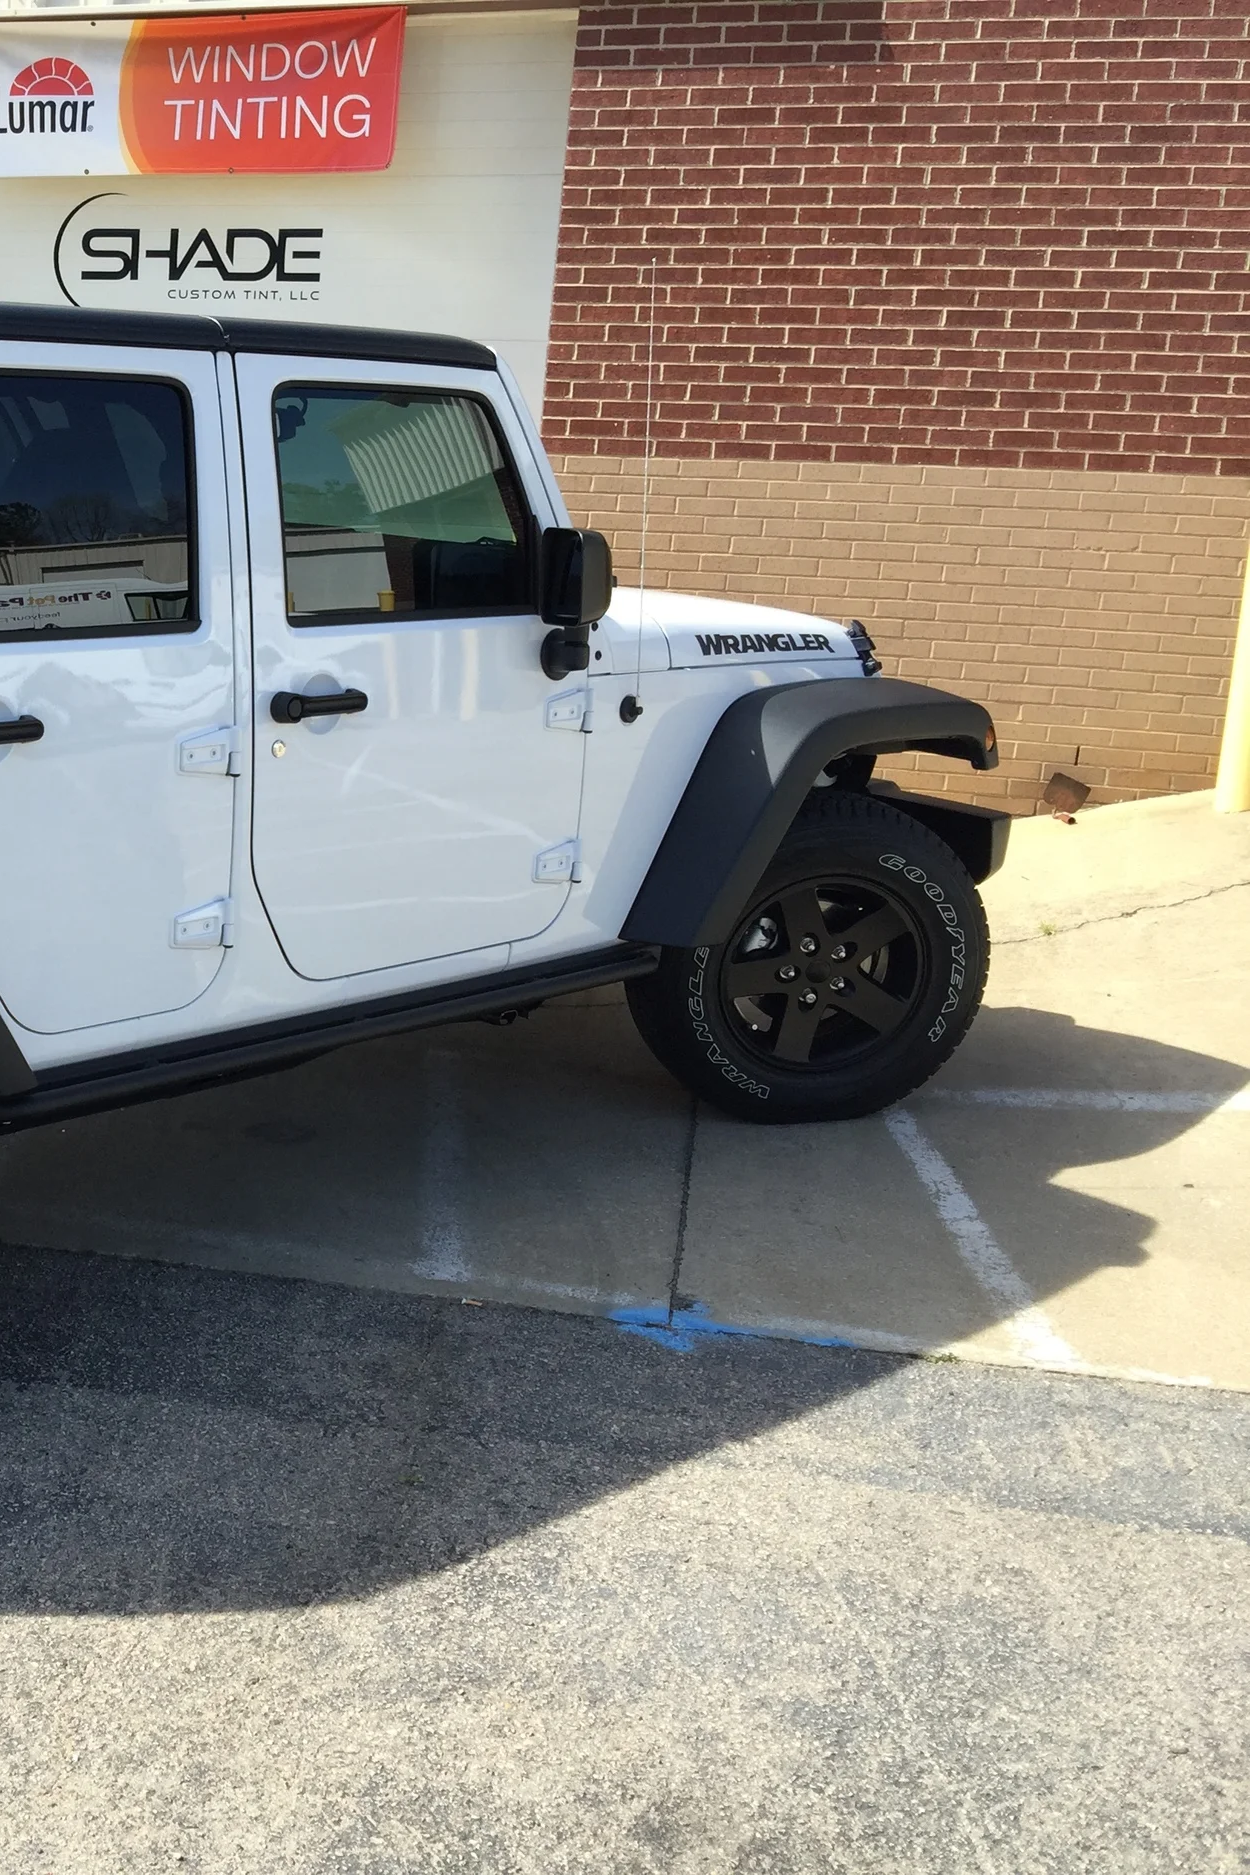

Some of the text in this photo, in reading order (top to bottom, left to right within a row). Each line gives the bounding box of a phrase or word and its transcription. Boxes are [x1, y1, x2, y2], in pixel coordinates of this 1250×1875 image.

[167, 37, 377, 84] WINDOW
[164, 94, 372, 141] TINTING
[80, 228, 324, 282] SHADE
[167, 289, 320, 302] CUSTOM TINT, LLC
[695, 633, 836, 656] WRANGLER
[878, 853, 967, 1043] GOODYEAR
[687, 946, 771, 1100] WRANGLE
